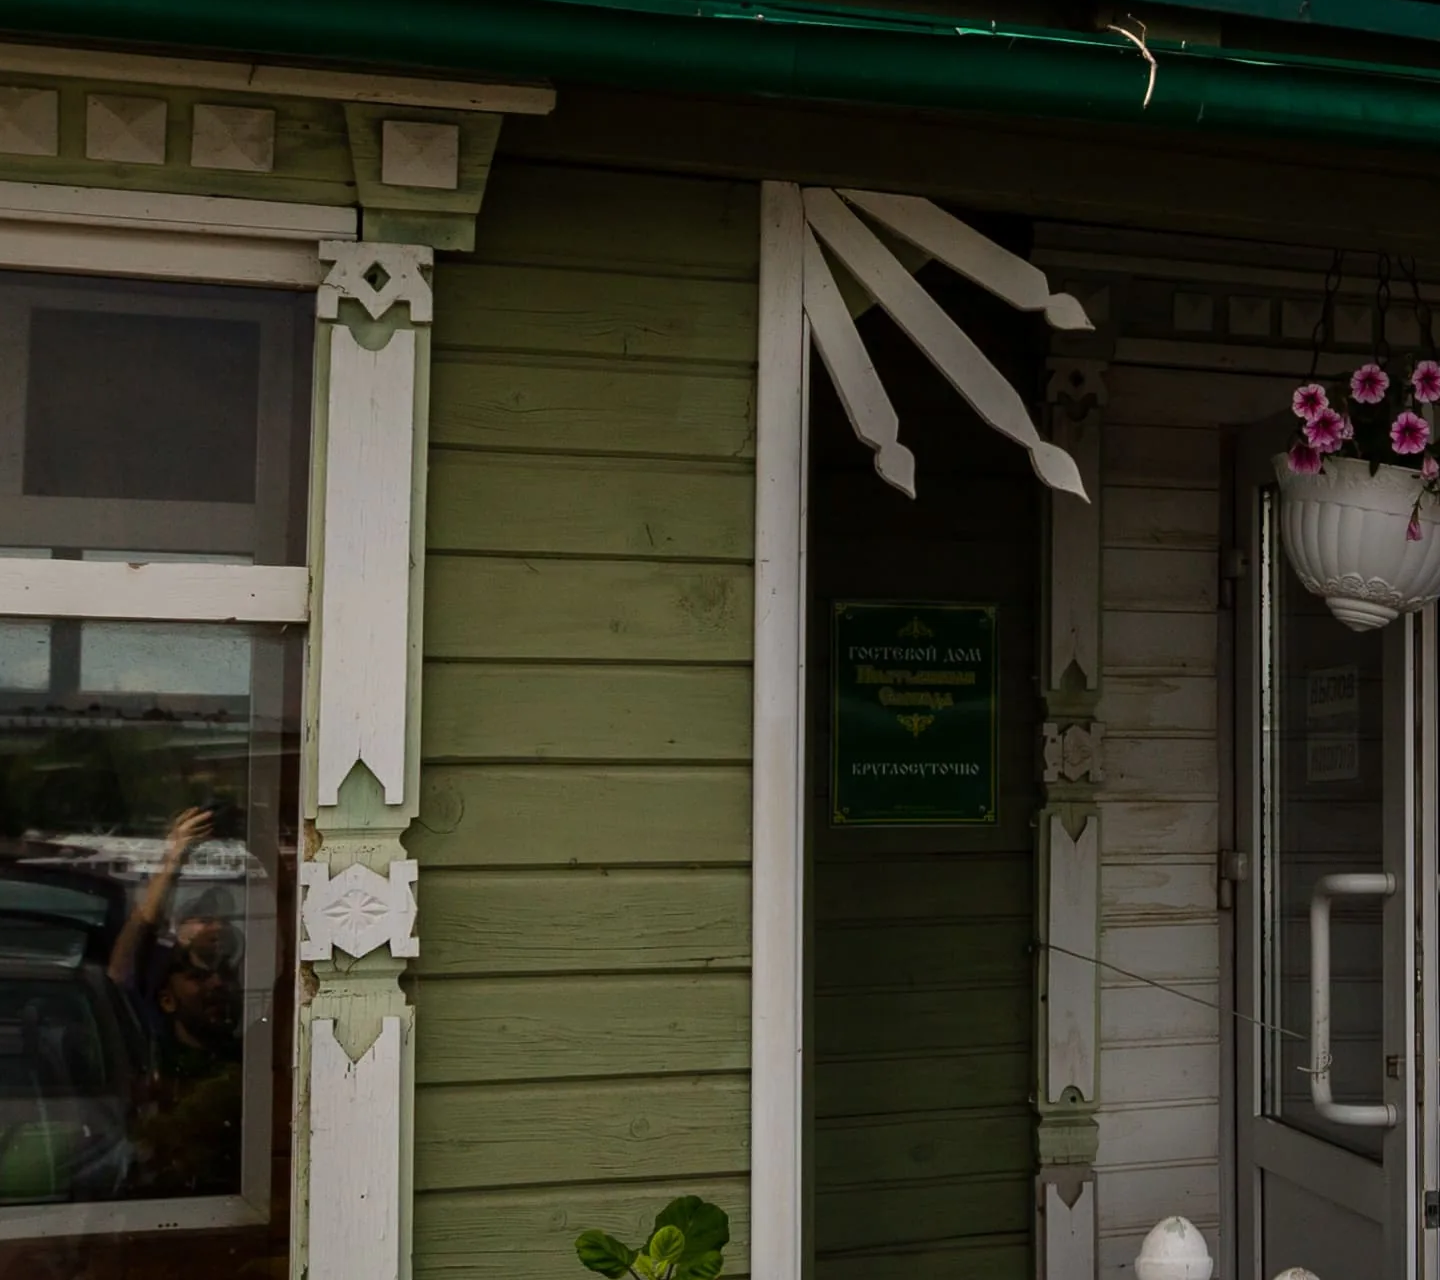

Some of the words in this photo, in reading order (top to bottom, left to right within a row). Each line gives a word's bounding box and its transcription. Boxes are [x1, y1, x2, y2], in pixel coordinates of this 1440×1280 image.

[848, 645, 937, 662] ГОСТЕВОЙ
[943, 648, 982, 663] ДОМ
[852, 762, 980, 779] КРУГЛОСУТОЧНО
